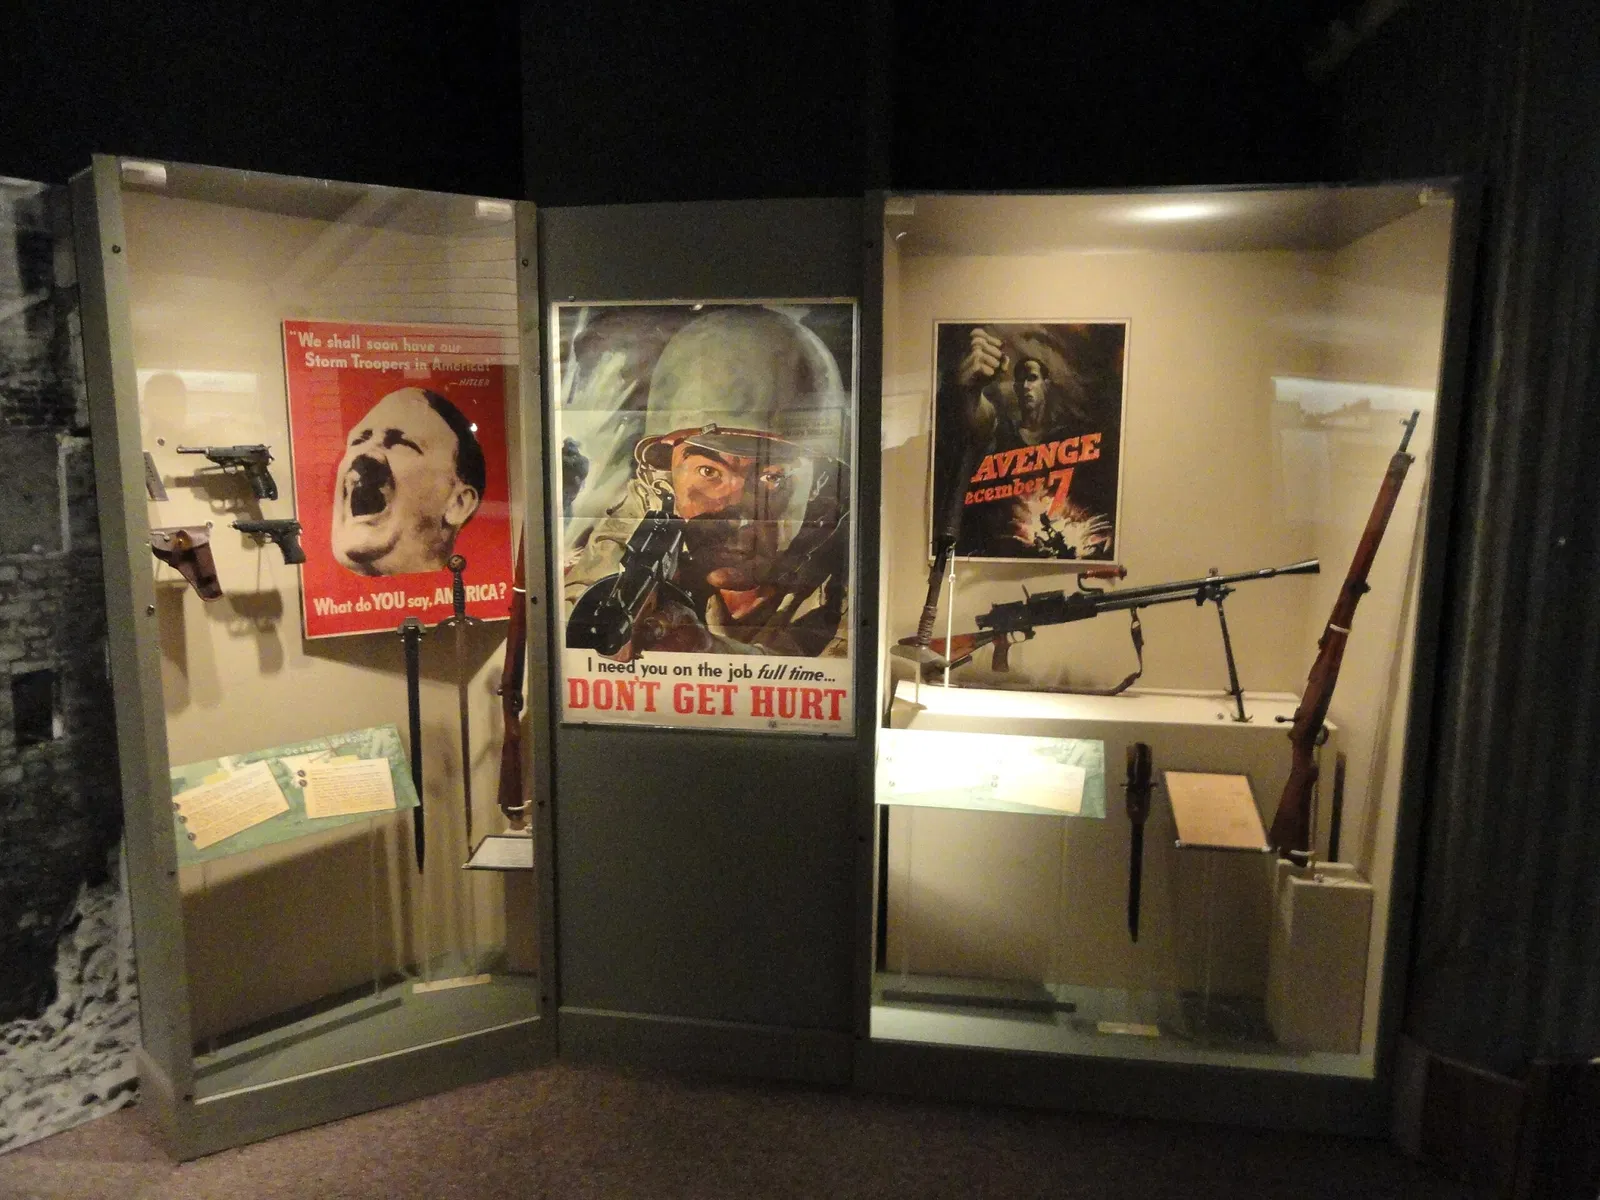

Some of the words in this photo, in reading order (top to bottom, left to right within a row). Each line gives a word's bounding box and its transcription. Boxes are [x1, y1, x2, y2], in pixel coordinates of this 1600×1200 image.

[327, 333, 360, 350] shall
[366, 339, 399, 351] soon
[403, 337, 435, 352] have
[440, 343, 462, 354] our
[305, 351, 348, 368] Storm
[351, 353, 411, 374] Troopers
[415, 358, 428, 371] in
[971, 433, 1102, 483] AVENGE
[964, 477, 1046, 506] ecember
[1048, 467, 1075, 517] 7
[313, 597, 352, 616] What
[355, 597, 372, 612] do
[370, 591, 406, 611] YOU
[408, 596, 433, 611] say,
[434, 582, 507, 605] AMRICA?
[587, 657, 592, 672] I
[598, 660, 635, 673] need
[640, 664, 668, 678] you
[673, 666, 693, 676] on
[698, 662, 723, 677] the
[727, 663, 753, 682] job
[757, 664, 788, 680] full
[789, 666, 836, 682] time...
[567, 676, 661, 713] DON'T
[673, 682, 738, 716] GET
[750, 685, 847, 721] HURT
